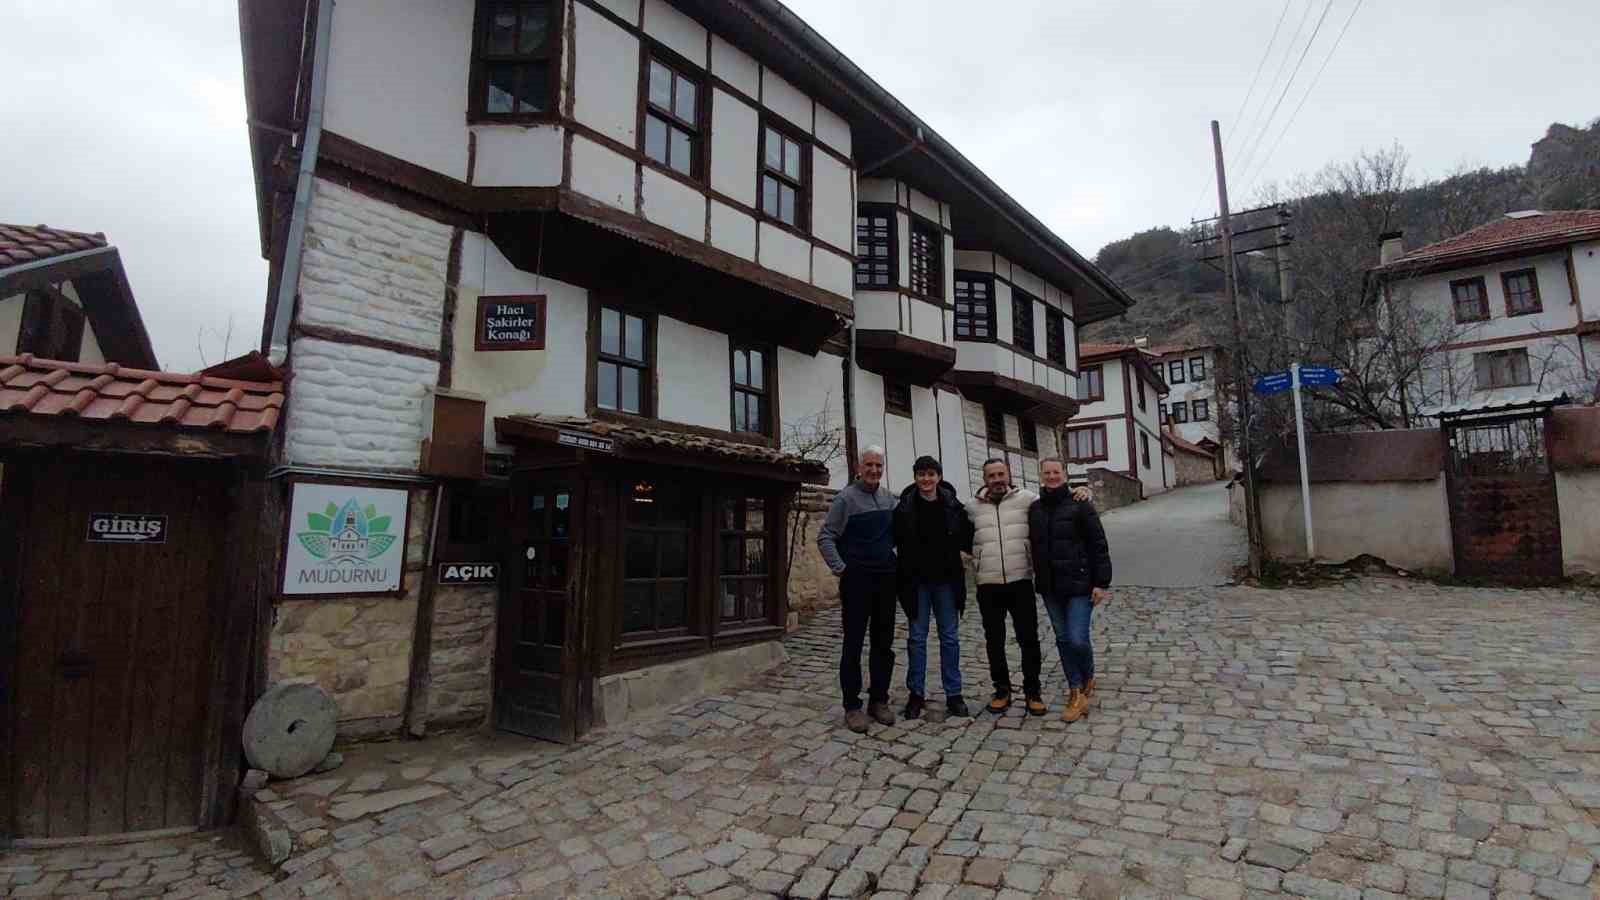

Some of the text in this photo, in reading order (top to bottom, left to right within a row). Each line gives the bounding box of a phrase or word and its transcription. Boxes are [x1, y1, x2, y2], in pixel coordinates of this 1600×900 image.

[497, 305, 524, 315] Hacı
[487, 317, 534, 328] Şakirler
[488, 329, 530, 342] Konağı
[93, 515, 161, 537] GİRİŞ
[298, 567, 388, 584] MUDURNU
[444, 566, 494, 581] AÇIK
